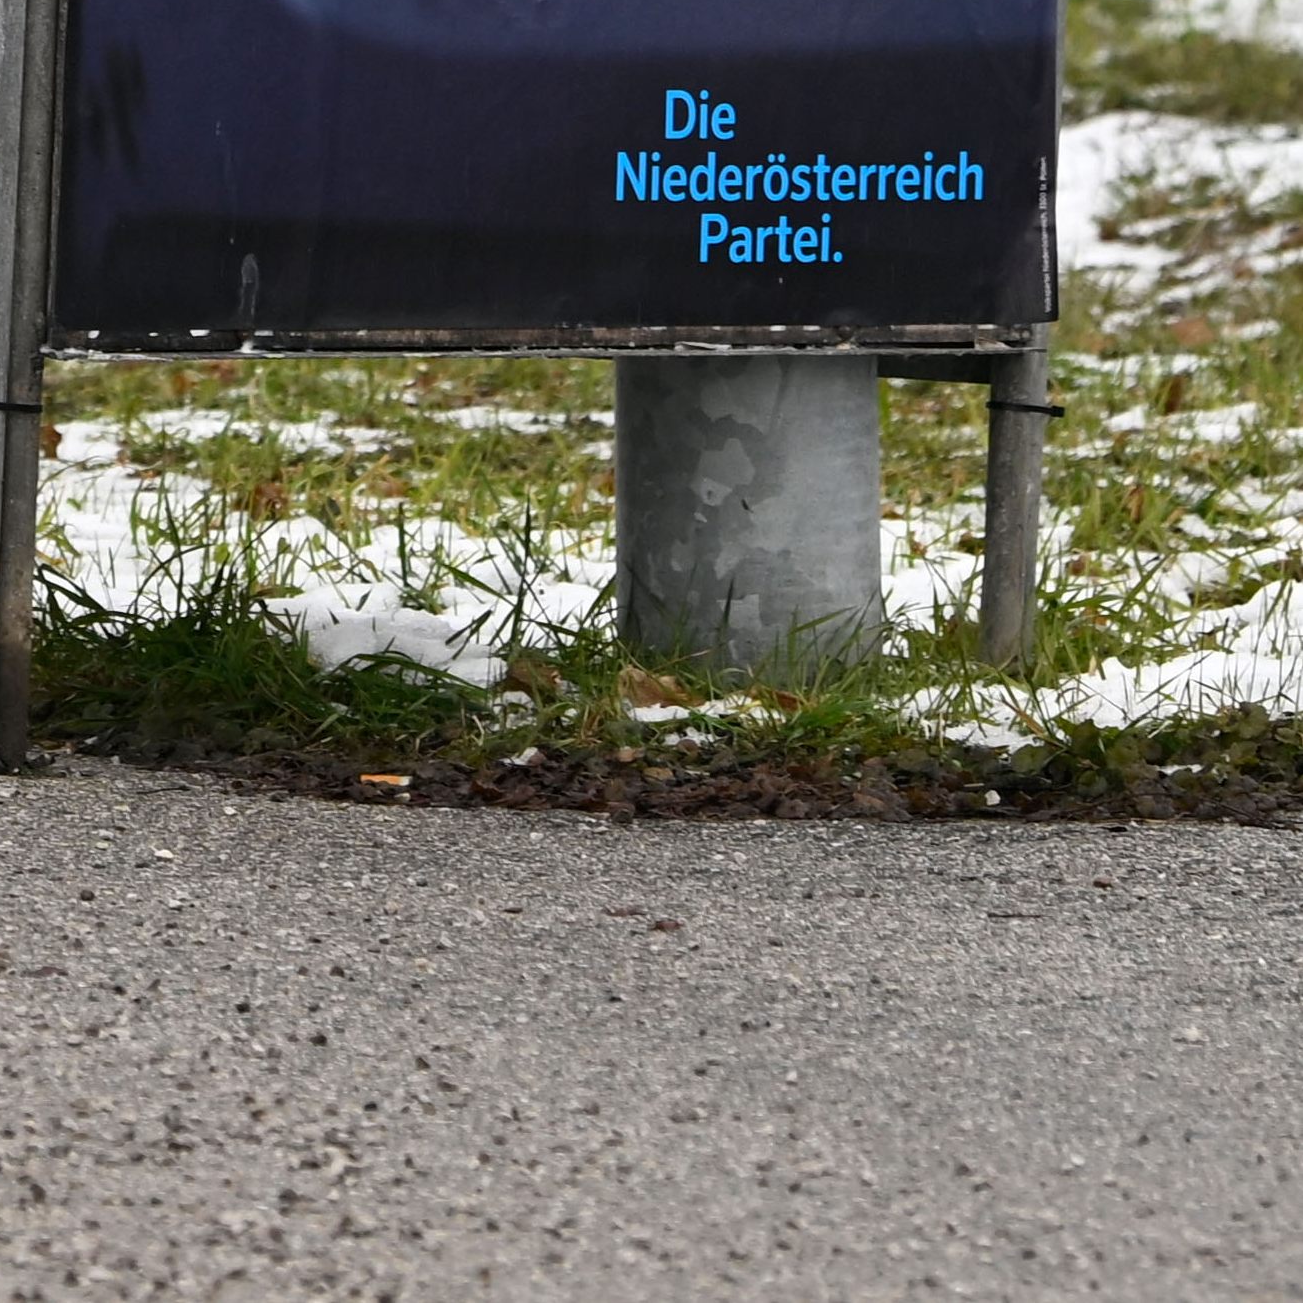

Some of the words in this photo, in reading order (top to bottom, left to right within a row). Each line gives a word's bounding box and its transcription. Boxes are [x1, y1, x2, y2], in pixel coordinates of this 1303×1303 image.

[664, 90, 736, 140] Die
[615, 151, 985, 202] Niederösterreich
[699, 213, 843, 264] Partei.
